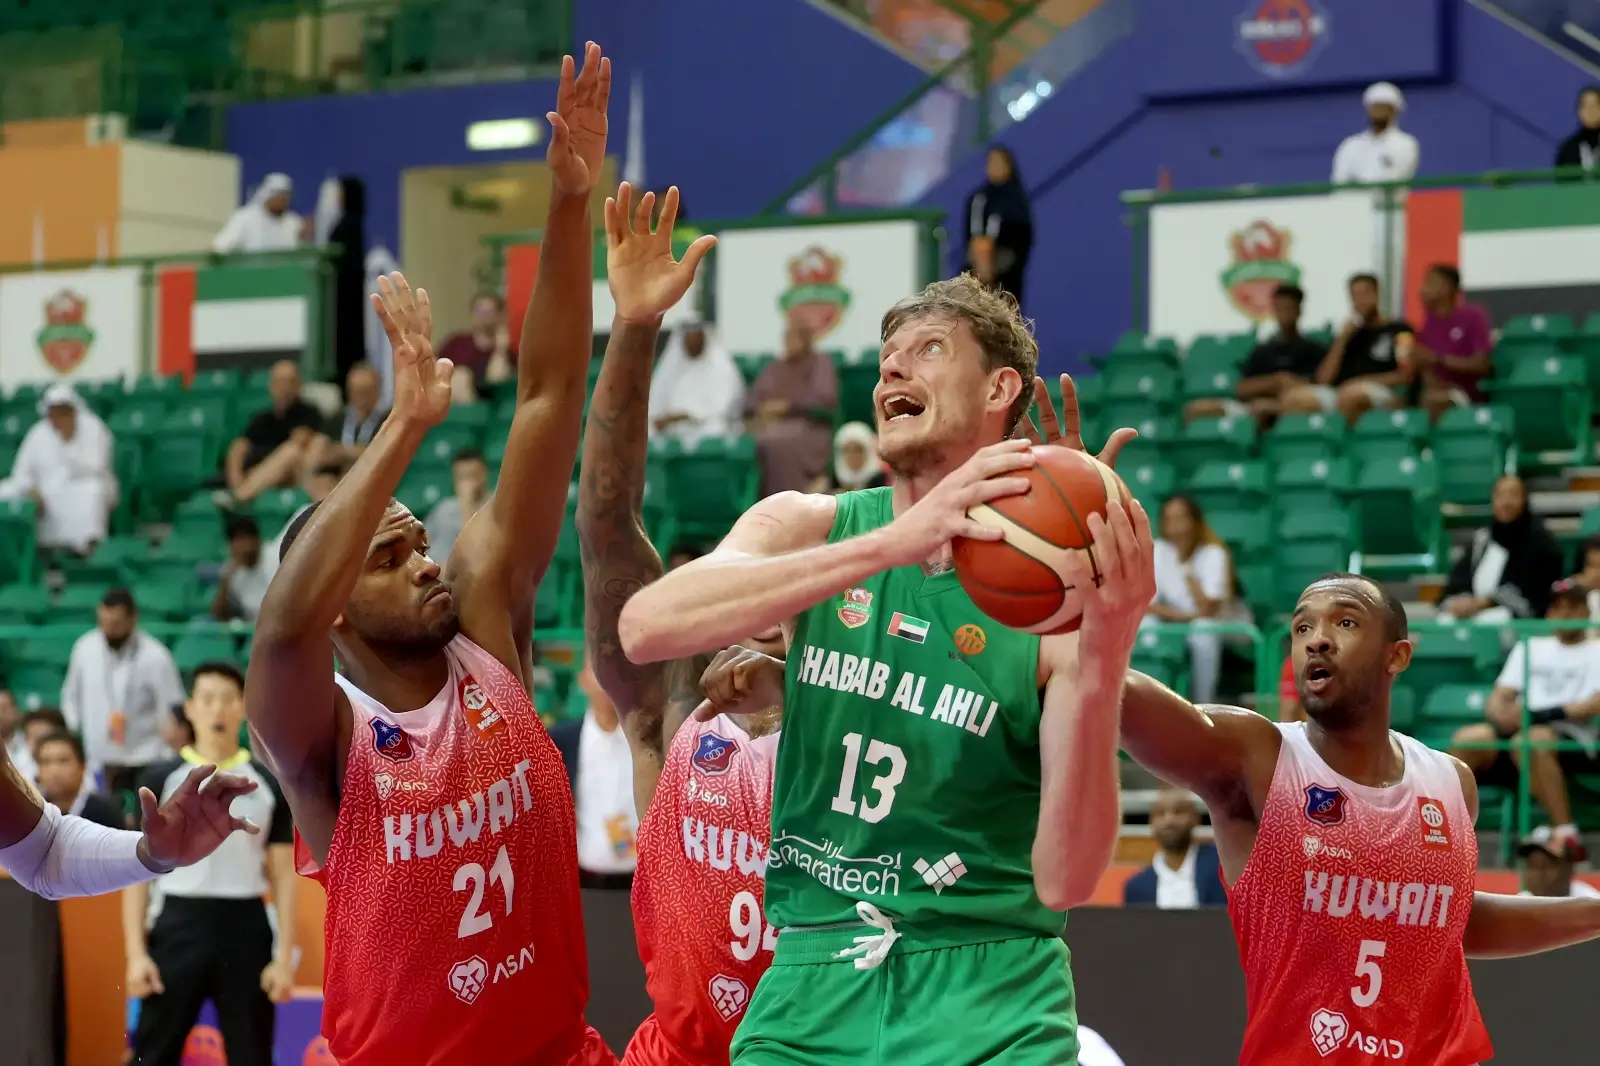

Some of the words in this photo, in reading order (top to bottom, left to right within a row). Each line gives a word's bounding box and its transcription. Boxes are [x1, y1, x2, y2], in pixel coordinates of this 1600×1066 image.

[890, 671, 926, 715] AL
[930, 683, 999, 738] AHLI
[696, 790, 728, 807] ASAD
[831, 732, 908, 824] 13
[682, 816, 767, 879] KUW
[768, 844, 900, 896] emaratech
[452, 844, 515, 939] 21
[1303, 870, 1454, 928] KUWAIT
[1350, 939, 1387, 1008] 5
[1347, 1031, 1404, 1060] ASAD
